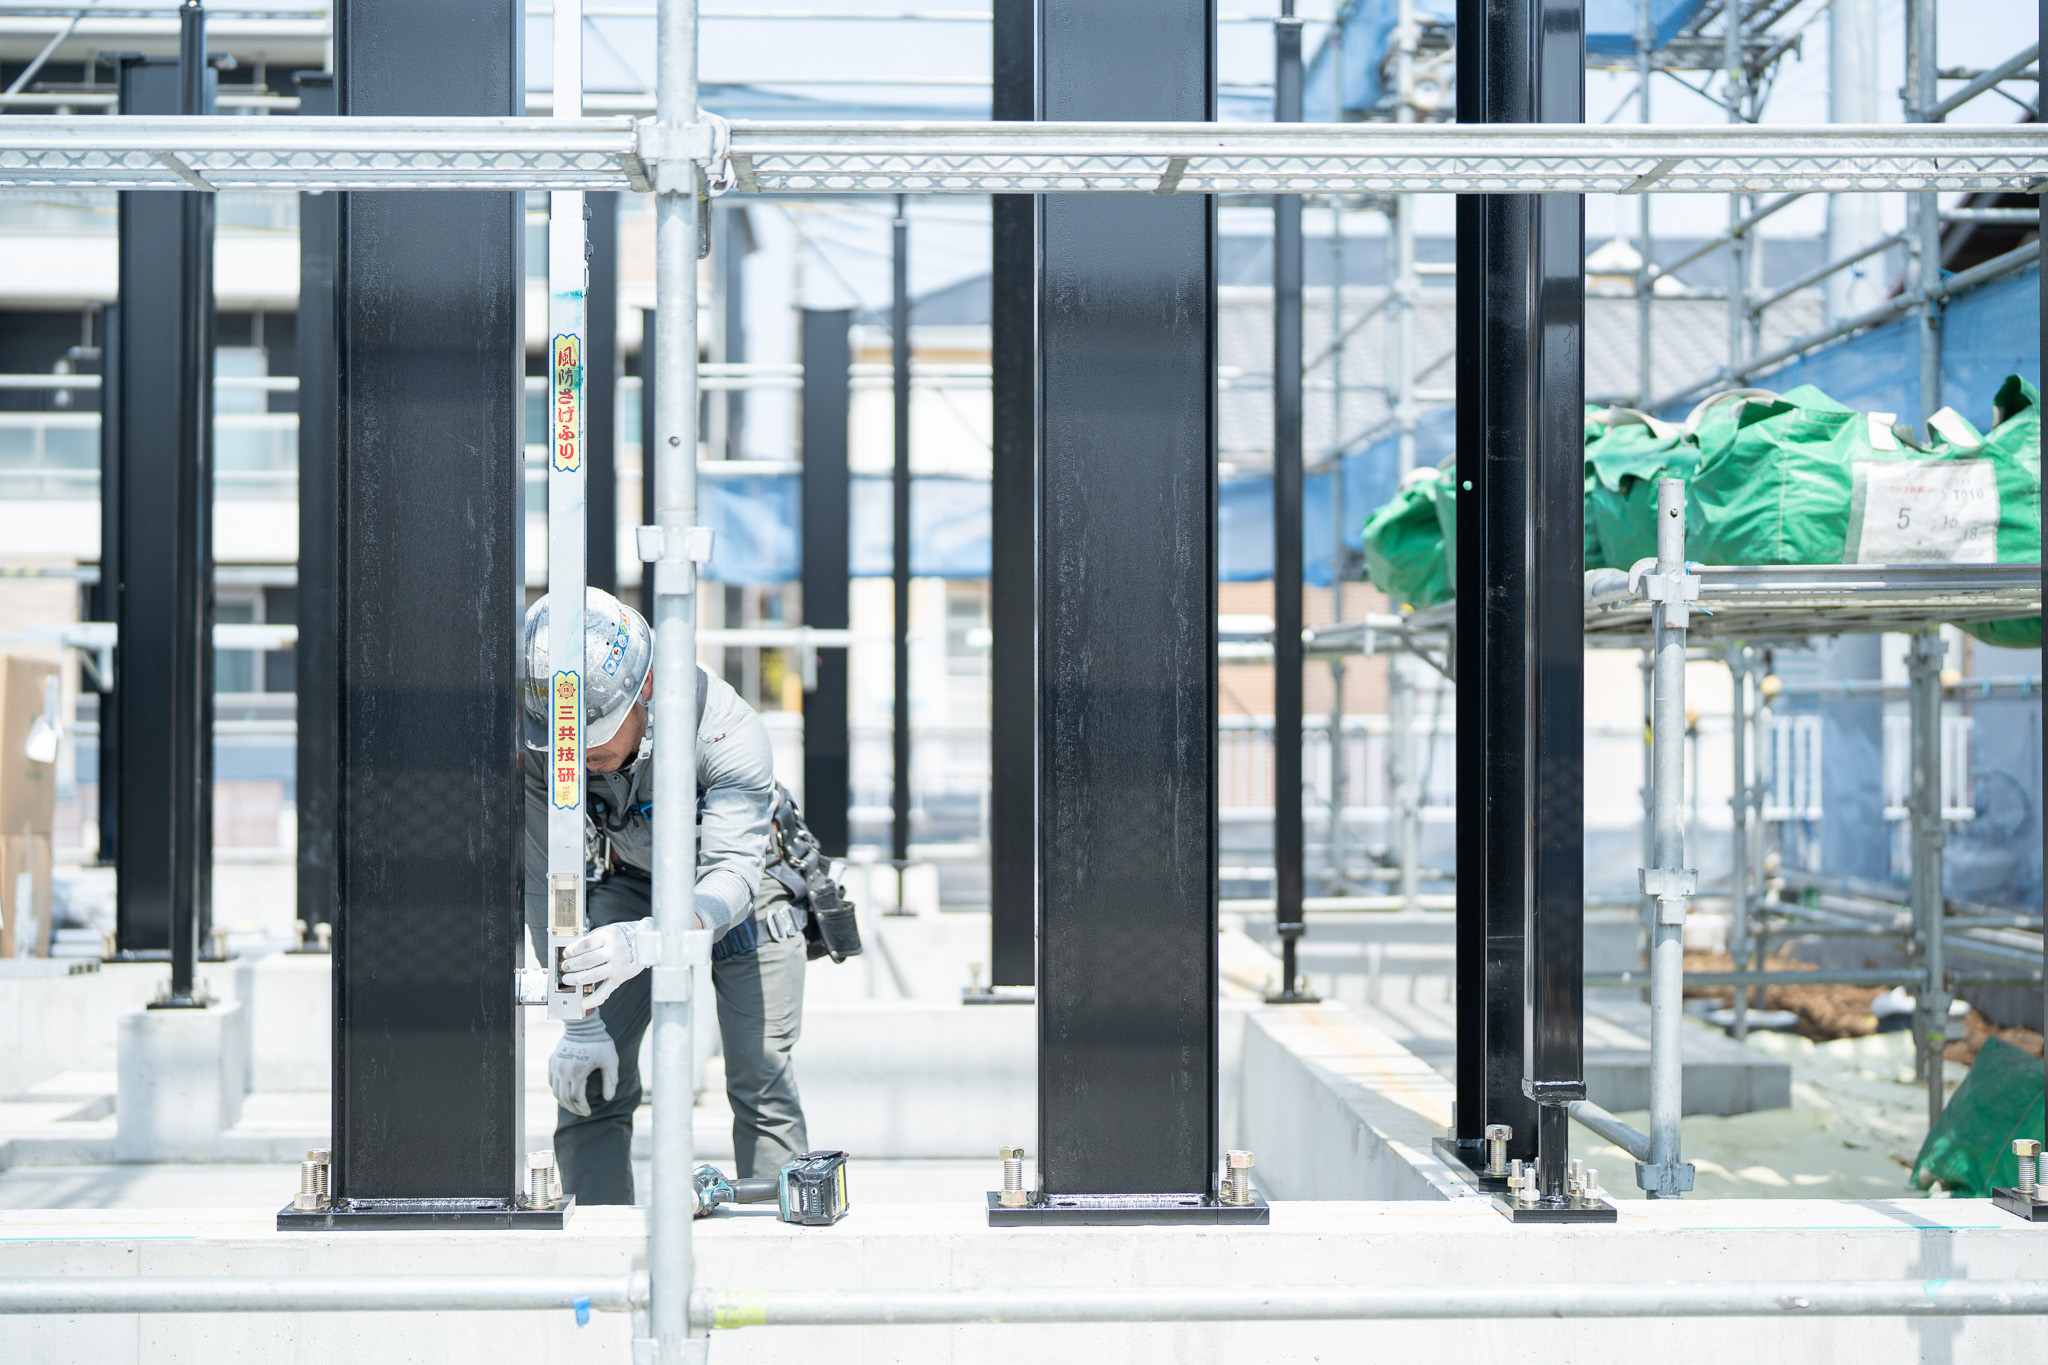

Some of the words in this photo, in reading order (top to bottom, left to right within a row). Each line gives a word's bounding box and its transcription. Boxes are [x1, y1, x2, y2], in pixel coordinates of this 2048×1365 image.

[557, 346, 577, 460] 風防さげふり
[1897, 507, 1911, 530] 5
[557, 705, 576, 783] 三共技研
